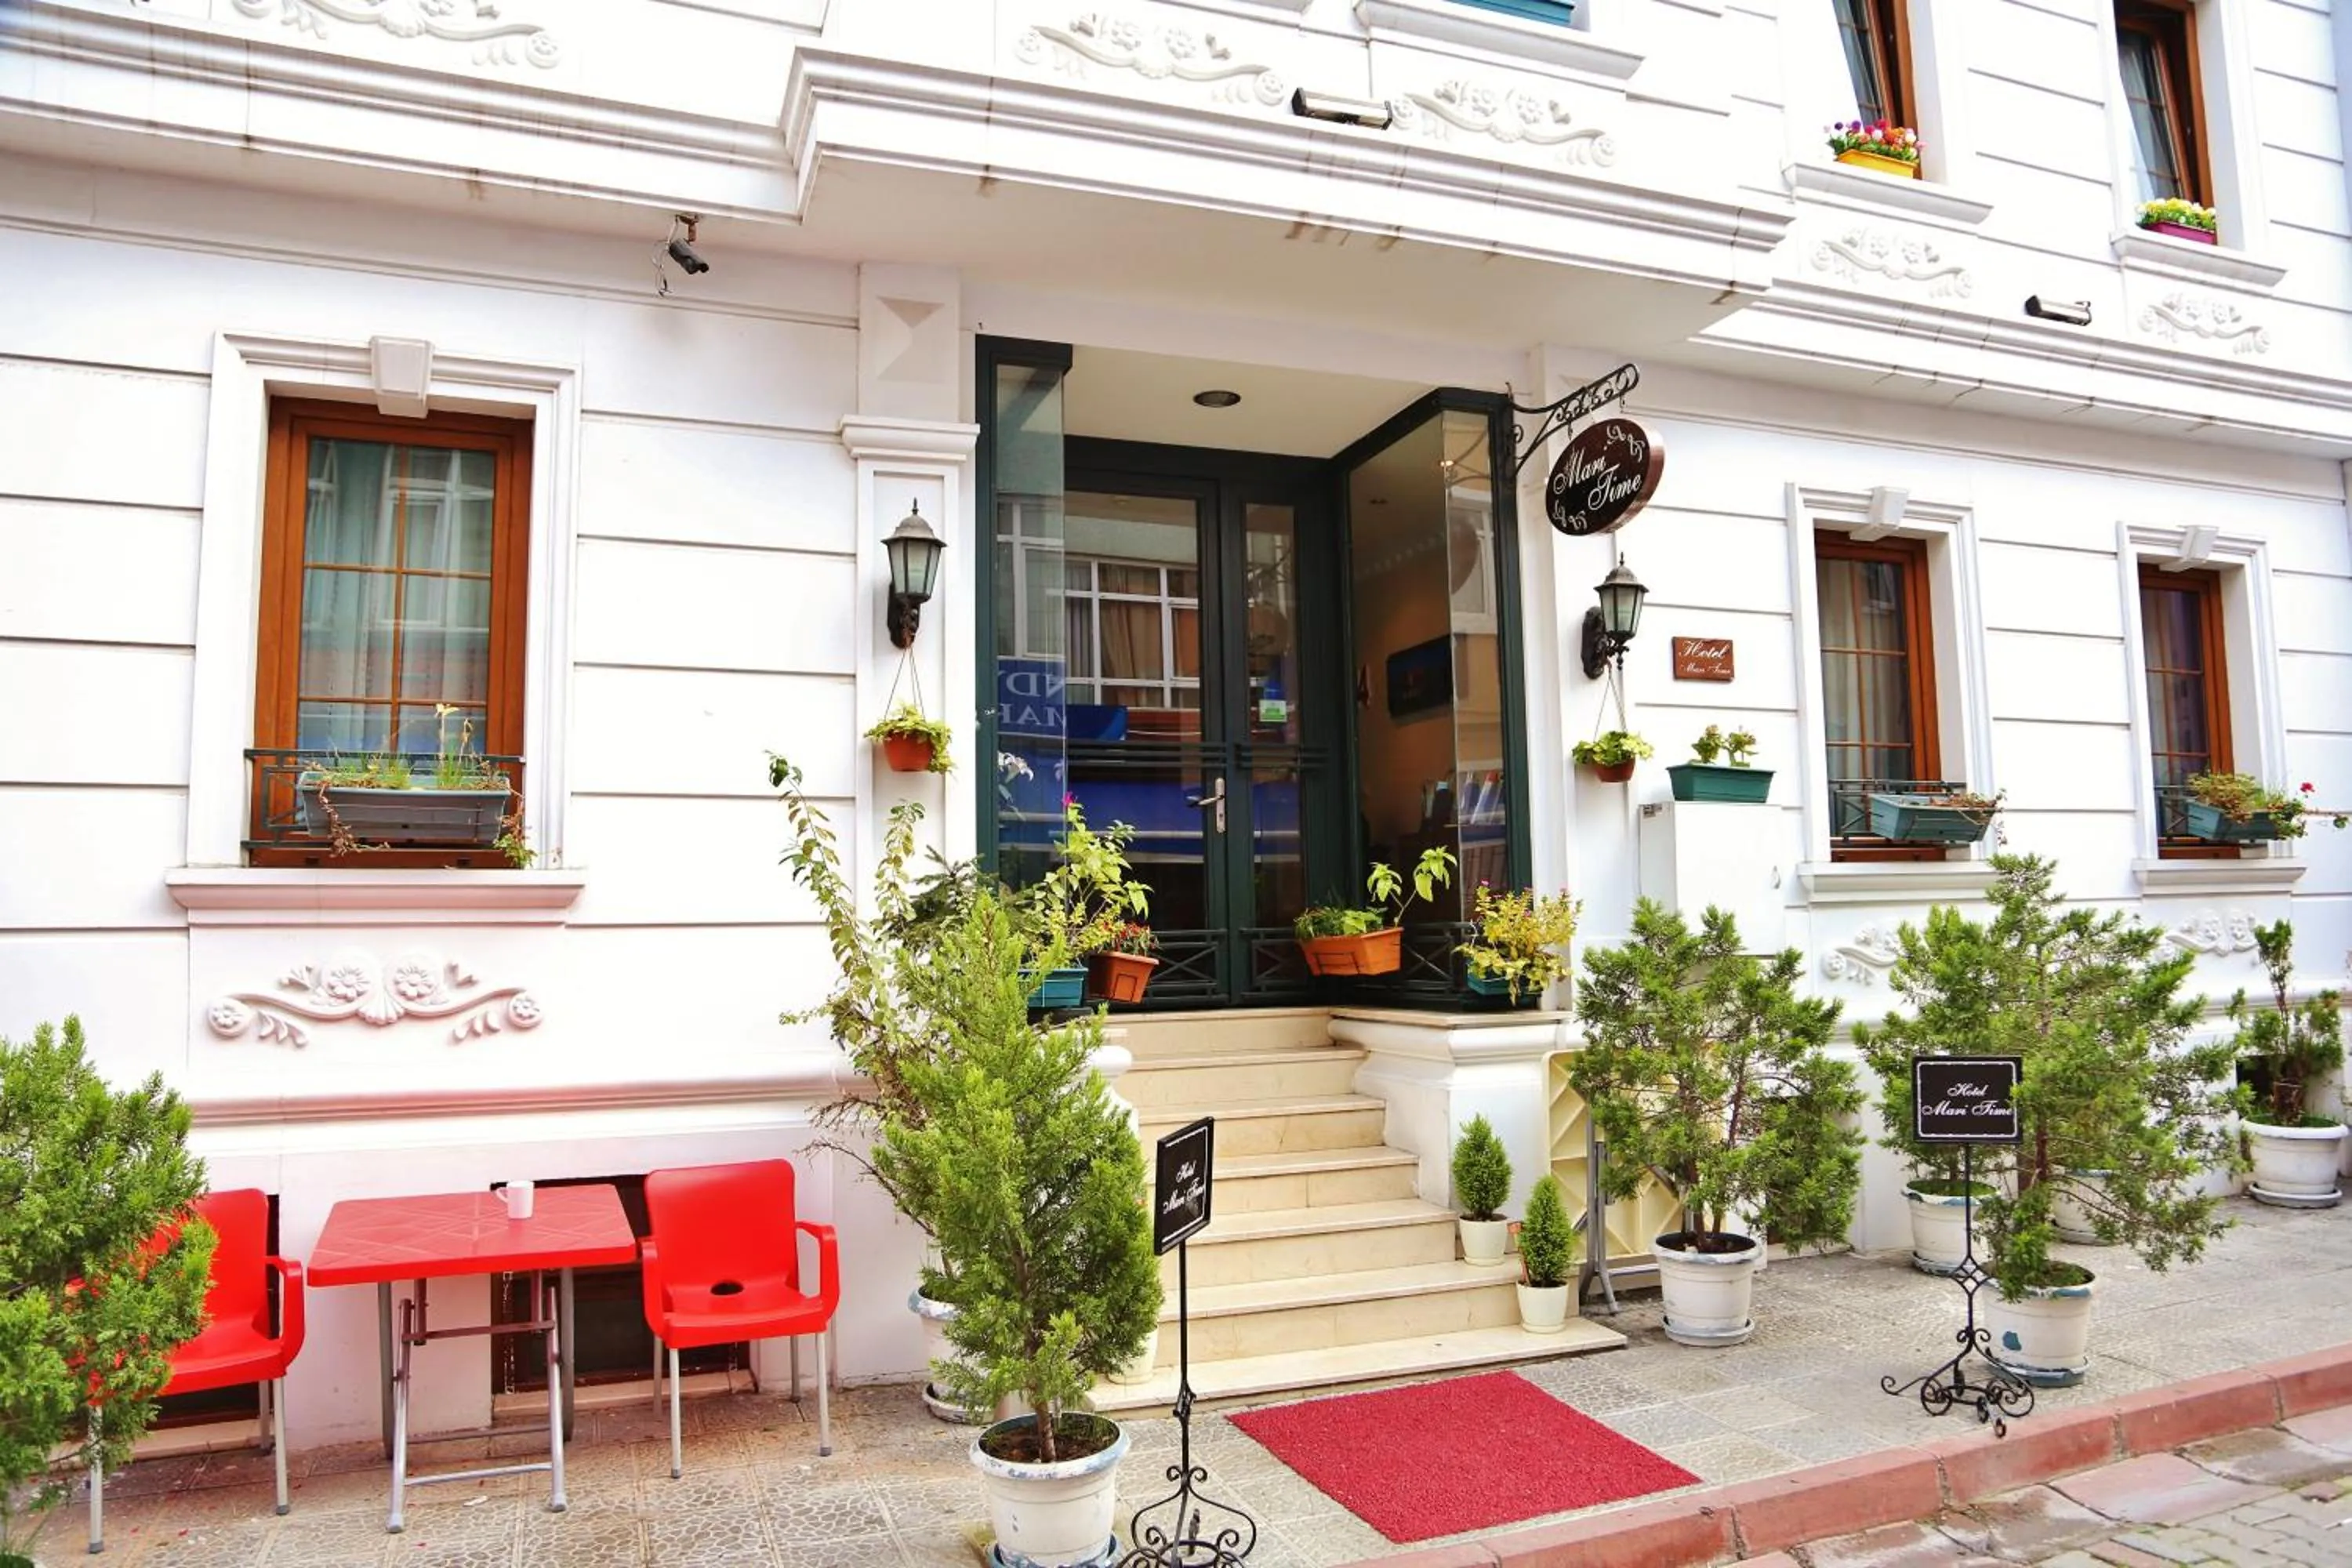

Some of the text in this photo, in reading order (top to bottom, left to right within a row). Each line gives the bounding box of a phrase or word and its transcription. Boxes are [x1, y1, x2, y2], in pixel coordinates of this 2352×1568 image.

[1553, 445, 1607, 494] Mari
[1588, 463, 1642, 510] Time
[1679, 641, 1730, 659] Hotel
[1947, 1083, 1989, 1097] Hotel
[1922, 1100, 2013, 1116] Mari Time
